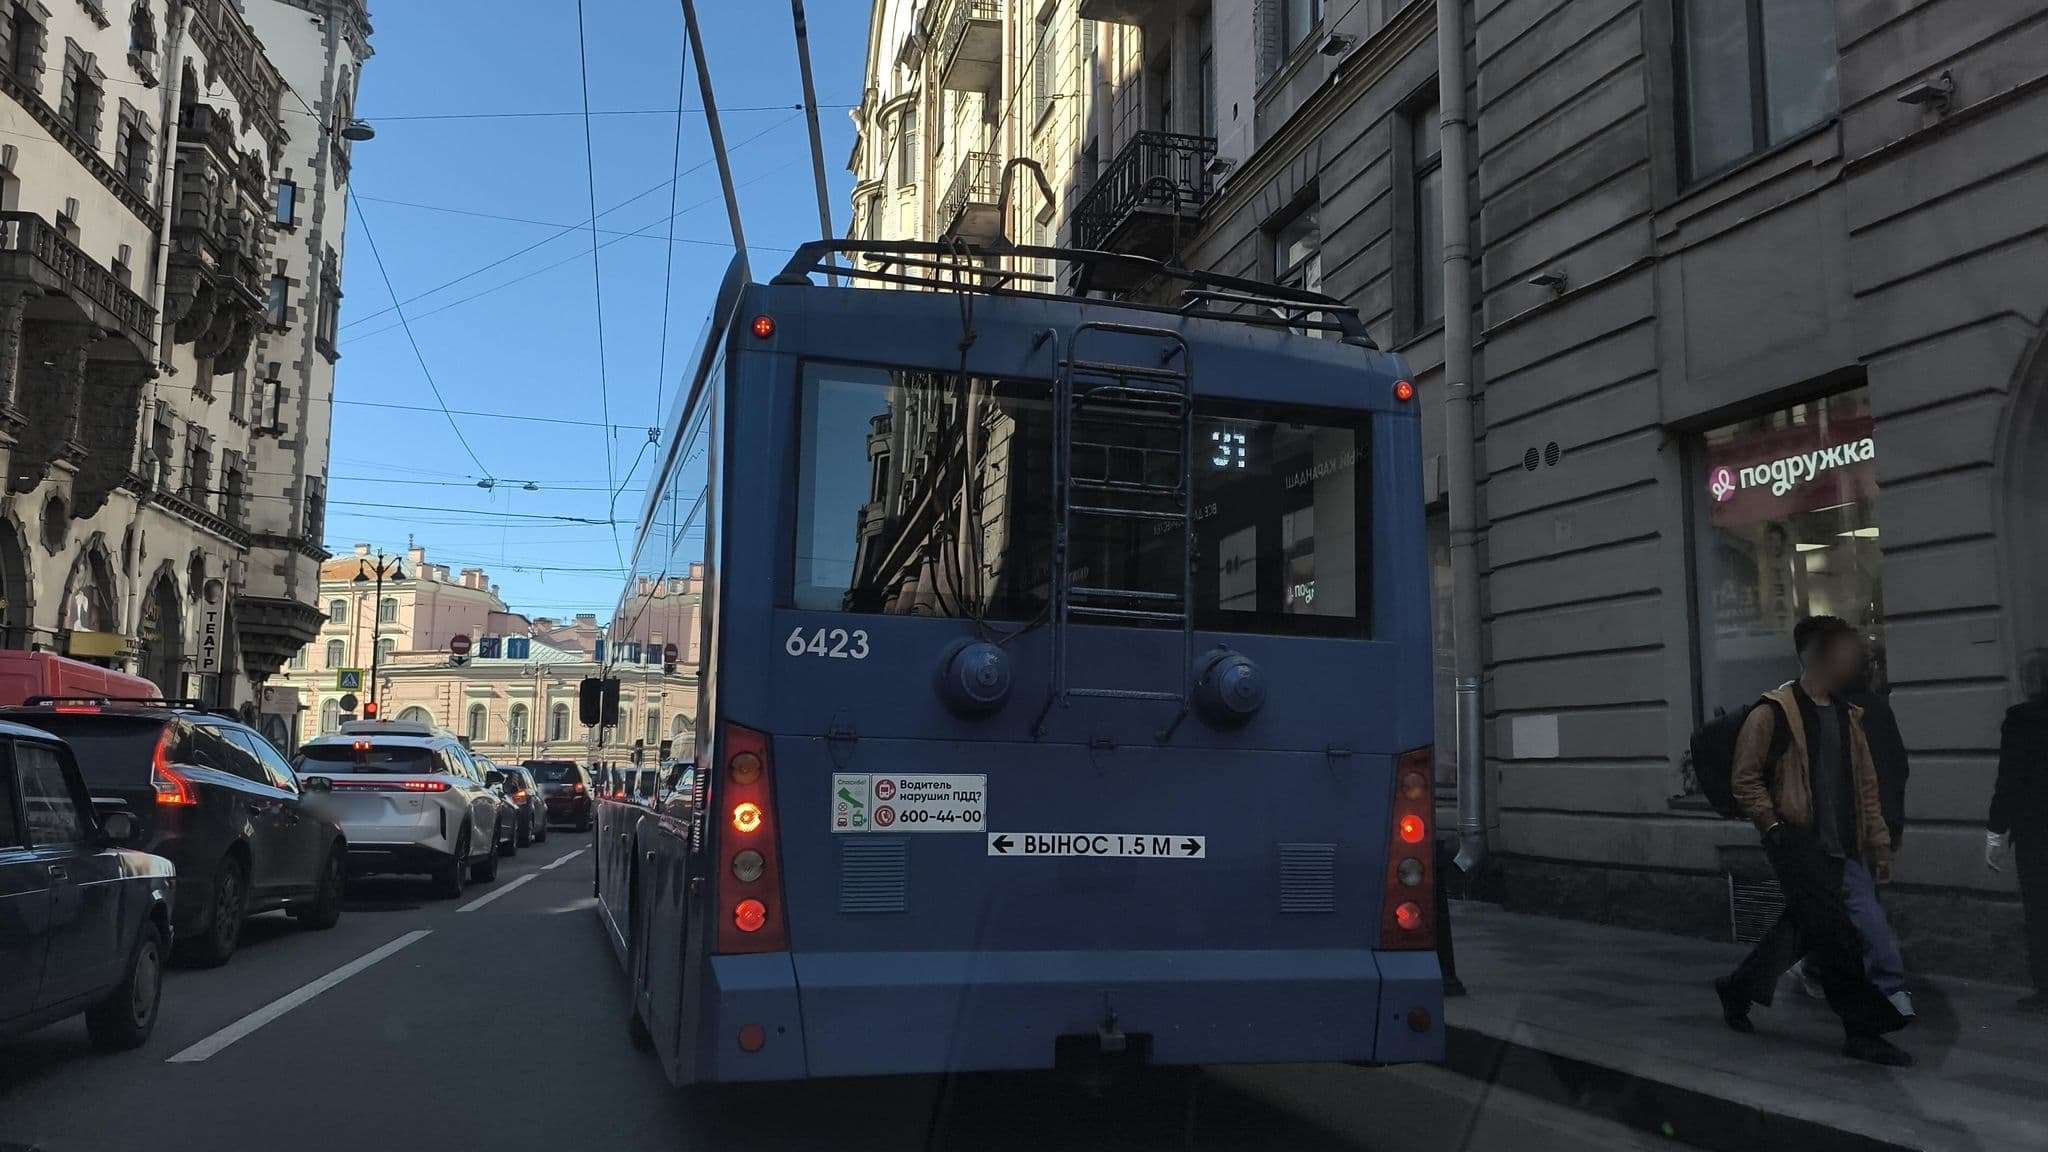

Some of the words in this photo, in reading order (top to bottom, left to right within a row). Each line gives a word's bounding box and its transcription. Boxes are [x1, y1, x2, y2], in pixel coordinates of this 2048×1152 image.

[1739, 437, 1875, 497] подружка
[203, 611, 217, 669] ТЕАТР
[785, 627, 870, 660] 6423
[900, 779, 952, 790] Водитель
[900, 793, 950, 803] нарушил
[953, 791, 982, 803] ПДД?
[900, 810, 981, 823] 600-44-00
[1024, 834, 1108, 855] ВЫНОС
[1117, 836, 1146, 856] 1.5
[1152, 837, 1171, 857] М
